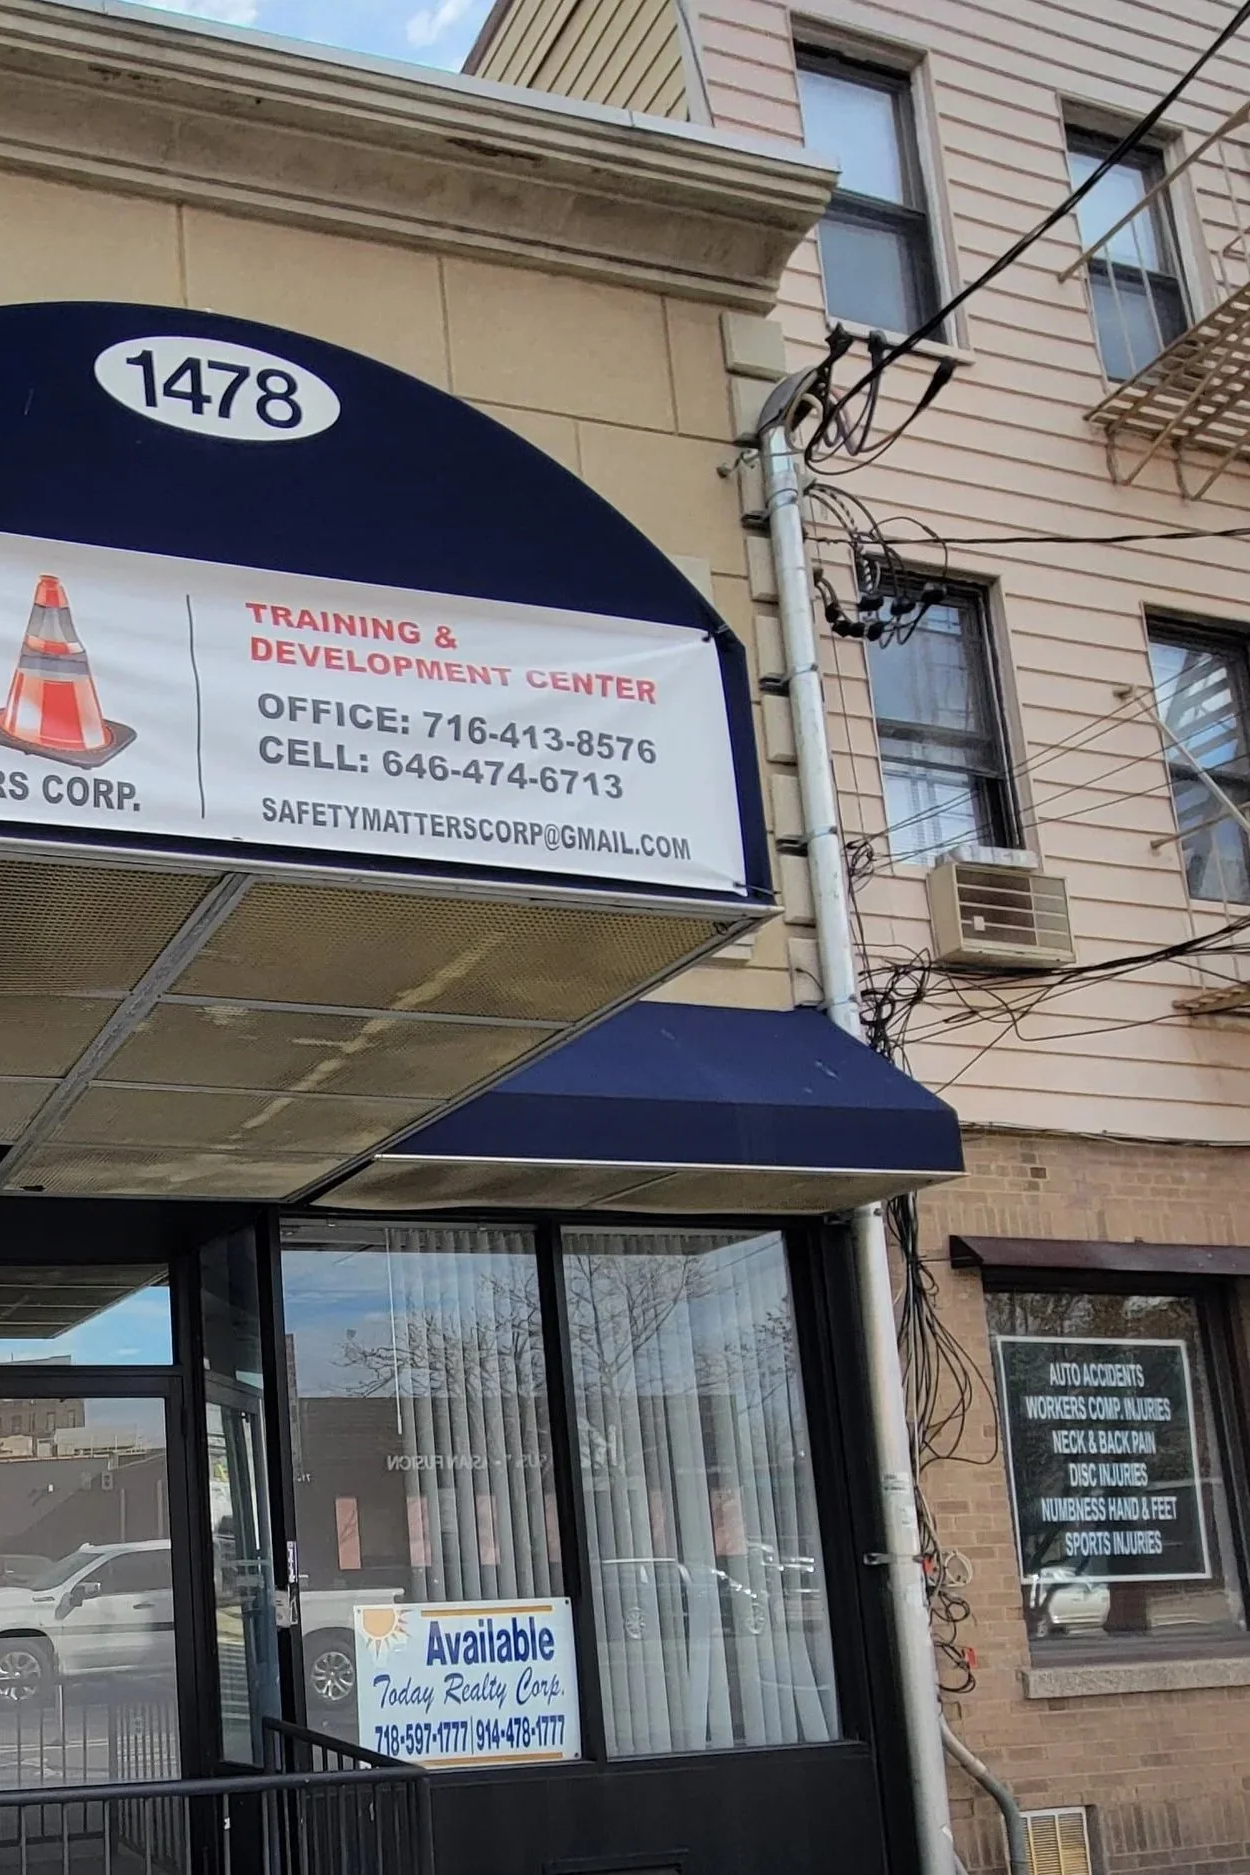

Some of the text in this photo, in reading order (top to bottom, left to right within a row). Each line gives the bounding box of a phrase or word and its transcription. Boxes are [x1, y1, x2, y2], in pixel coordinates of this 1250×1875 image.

[125, 349, 303, 429] 1478
[246, 601, 458, 650] TRAINING &
[250, 636, 657, 704] DEVELOPMENT CENTER
[257, 692, 657, 764] OFFICE: 716-413-8576
[258, 735, 624, 800] CELL: 646-474-6713
[43, 774, 142, 812] CORP.
[261, 797, 692, 861] SAFETYMATTERSCORP@GMAIL.COM
[1049, 1363, 1145, 1387] AUTO ACCIDENTS
[1024, 1397, 1171, 1422] WORKERS COMP. INJURIES
[1052, 1430, 1156, 1455] NECK & BACK PAIN
[1069, 1463, 1148, 1487] DISC INJURIES
[1041, 1496, 1177, 1522] NUMBNESS HAND & FEET
[1065, 1531, 1162, 1556] SPORTS INJURIES
[426, 1616, 555, 1666] Available
[372, 1666, 565, 1714] Today Realty Corp.
[374, 1714, 565, 1757] 718-597-1777 914-478-1777
